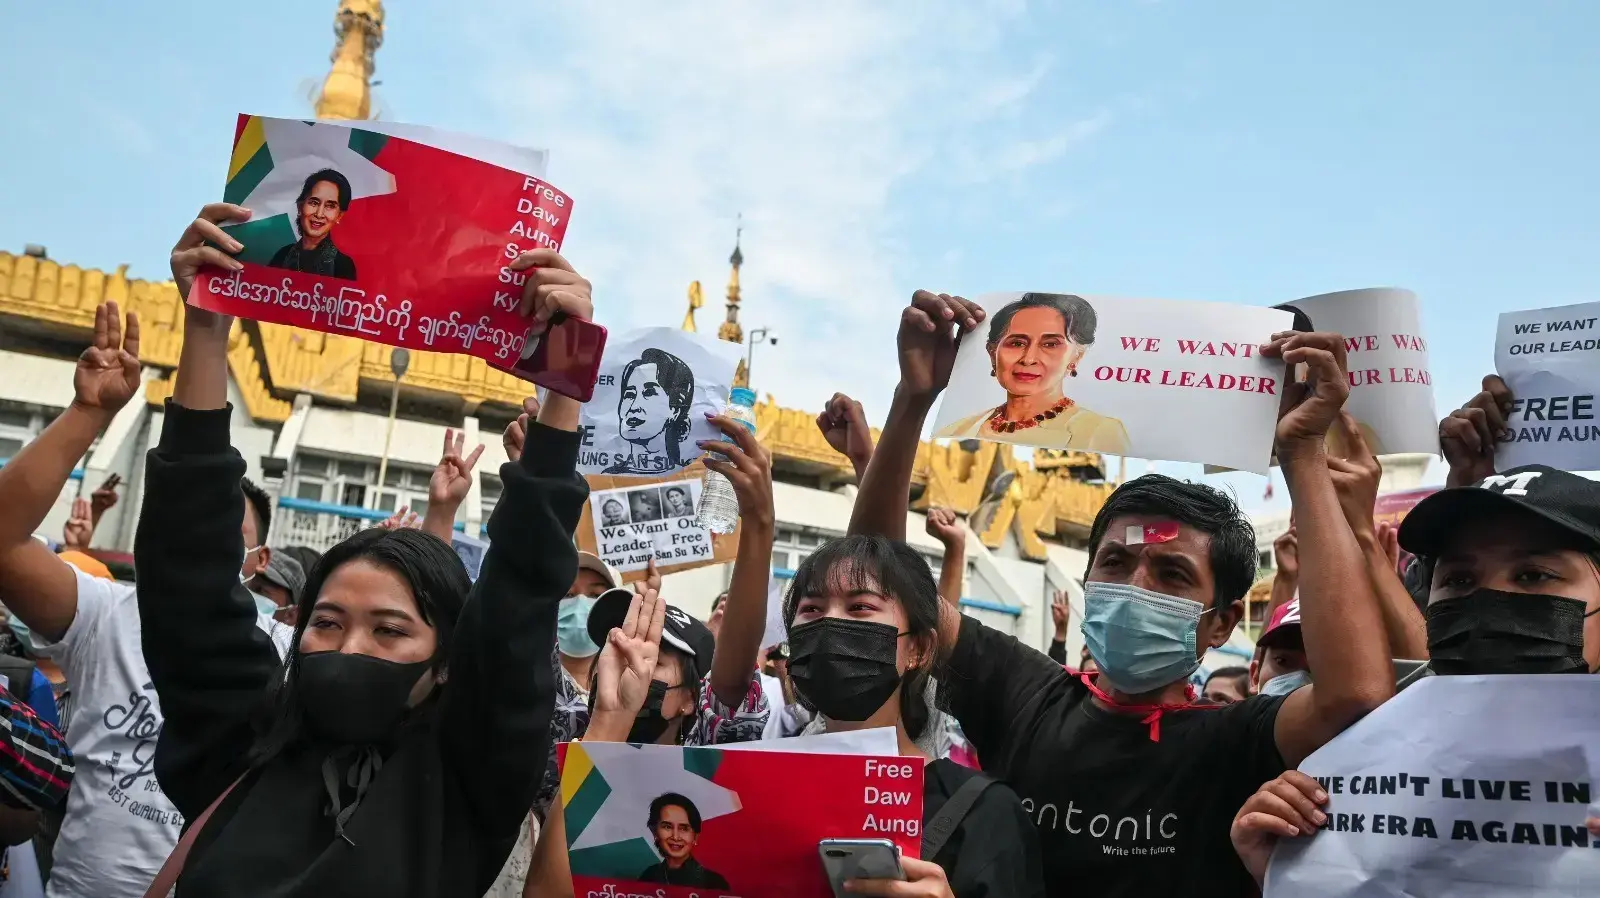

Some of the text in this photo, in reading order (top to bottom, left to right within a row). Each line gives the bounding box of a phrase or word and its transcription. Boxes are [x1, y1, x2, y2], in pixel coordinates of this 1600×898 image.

[522, 176, 565, 208] Free
[516, 198, 559, 227] Daw
[498, 266, 526, 287] Su
[493, 290, 521, 312] Ky
[1514, 318, 1598, 335] WE WANT
[1120, 336, 1258, 358] WE WANT
[1343, 335, 1379, 354] WE
[1509, 343, 1545, 355] OUR
[1094, 366, 1277, 396] OUR LEADER
[1347, 368, 1383, 387] UR
[1509, 394, 1594, 421] FREE
[1498, 426, 1552, 443] DAW
[613, 452, 648, 469] SAN
[599, 527, 626, 540] We
[630, 522, 669, 535] Want
[602, 533, 703, 555] Leader Free
[655, 550, 673, 560] San
[674, 547, 687, 558] Su
[692, 543, 709, 557] Kyi
[865, 759, 913, 778] Free
[864, 786, 912, 805] Daw
[1349, 772, 1430, 797] CAN'T
[1441, 777, 1531, 802] LIVE
[1544, 781, 1591, 804] IN
[108, 784, 131, 808] BEST
[128, 800, 169, 825] QUALITY
[862, 813, 919, 837] Aung
[1320, 812, 1365, 833] ARK
[1372, 814, 1438, 839] ERA
[1102, 844, 1176, 856] Write the future
